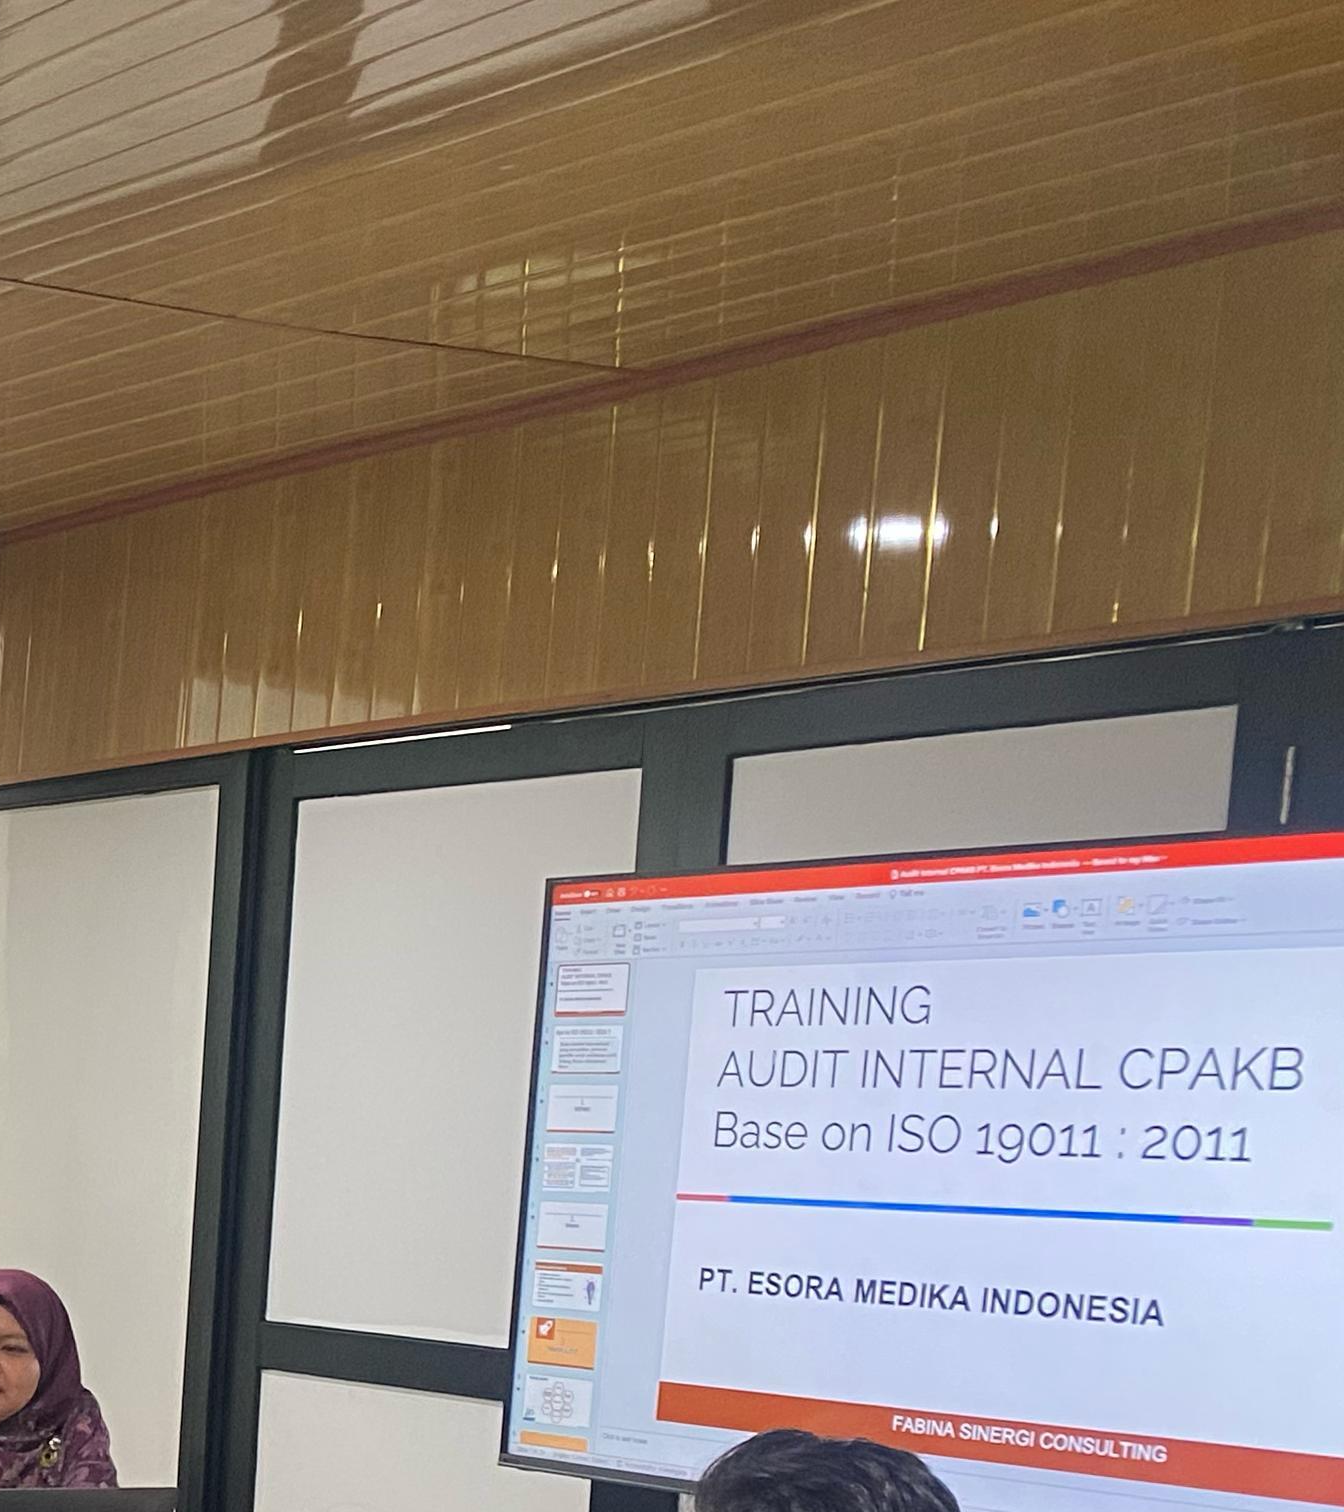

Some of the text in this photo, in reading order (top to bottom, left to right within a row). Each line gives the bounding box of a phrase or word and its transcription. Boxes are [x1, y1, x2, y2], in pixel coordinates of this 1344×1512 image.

[724, 985, 931, 1027] TRAINING
[717, 1047, 1304, 1091] AUDIT INTERNAL CPAKB
[714, 1111, 808, 1150] Base
[822, 1122, 871, 1152] on
[888, 1113, 961, 1154] ISO
[976, 1123, 1102, 1164] 19011
[1141, 1124, 1251, 1162] 2011
[698, 1267, 1165, 1327] PT. ESORA MEDIKA INDONESIA
[892, 1414, 1168, 1462] FABINA SINERGI CONSULTING
